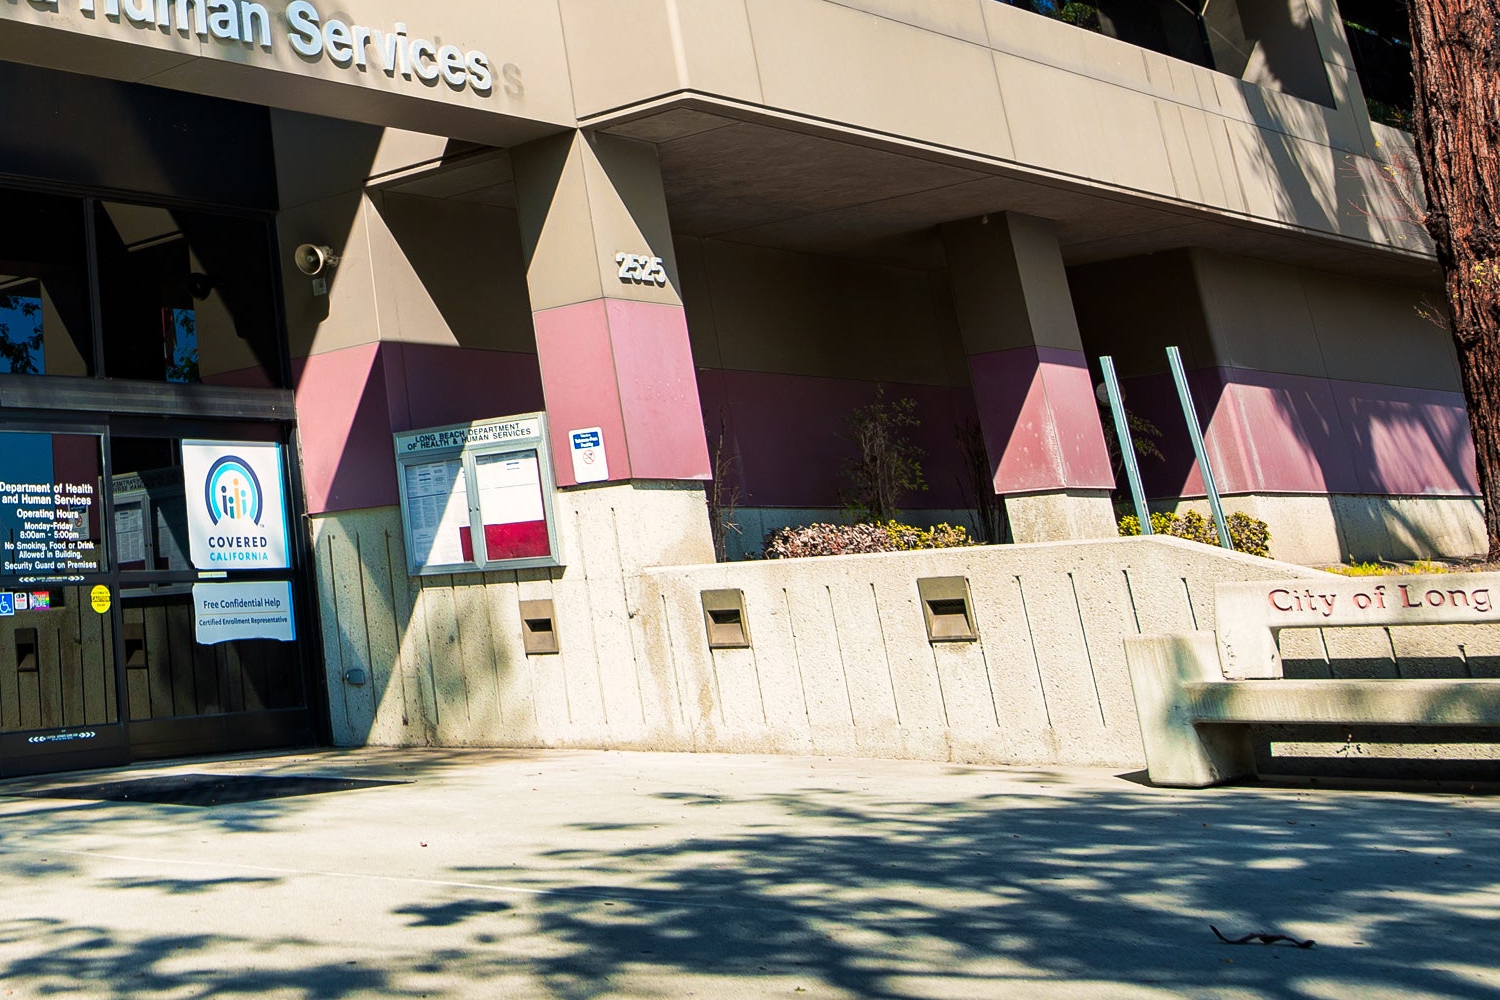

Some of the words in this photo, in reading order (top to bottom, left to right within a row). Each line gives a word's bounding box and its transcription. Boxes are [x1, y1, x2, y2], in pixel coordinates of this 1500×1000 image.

[285, 0, 493, 91] Services
[615, 252, 666, 284] 2525
[415, 434, 436, 443] LONG
[439, 430, 465, 440] BEACH
[468, 422, 520, 436] DEPARTMENT
[407, 442, 418, 451] OF
[420, 439, 449, 449] HEALTH
[461, 433, 489, 444] HUMAN
[493, 428, 531, 439] SERVICES
[53, 483, 63, 493] of
[65, 483, 93, 494] Health
[1, 494, 18, 504] and
[21, 494, 51, 504] Human
[54, 495, 92, 506] Services
[16, 508, 54, 520] Operating
[56, 509, 79, 519] Hours
[24, 522, 73, 531] Monday-Friday
[20, 531, 45, 539] 8:00am
[53, 530, 79, 540] 5:00pm
[4, 542, 14, 550] No
[16, 542, 47, 551] Smoking,
[49, 541, 66, 549] Food
[77, 541, 94, 549] Drink
[208, 536, 267, 548] COVERED
[18, 550, 45, 558] Allowed
[46, 550, 53, 558] in
[54, 550, 83, 559] Building.
[210, 551, 269, 562] CALIFORNIA
[4, 561, 33, 570] Security
[34, 561, 55, 569] Guard
[67, 560, 97, 569] Premises
[203, 600, 219, 609] Free
[220, 597, 263, 609] Confidential
[264, 597, 281, 608] Help
[1267, 589, 1337, 617] City
[1352, 585, 1386, 609] of
[1397, 584, 1493, 613] Long
[199, 618, 222, 627] Certified
[222, 618, 250, 626] Enrollment
[251, 616, 288, 625] Representative
